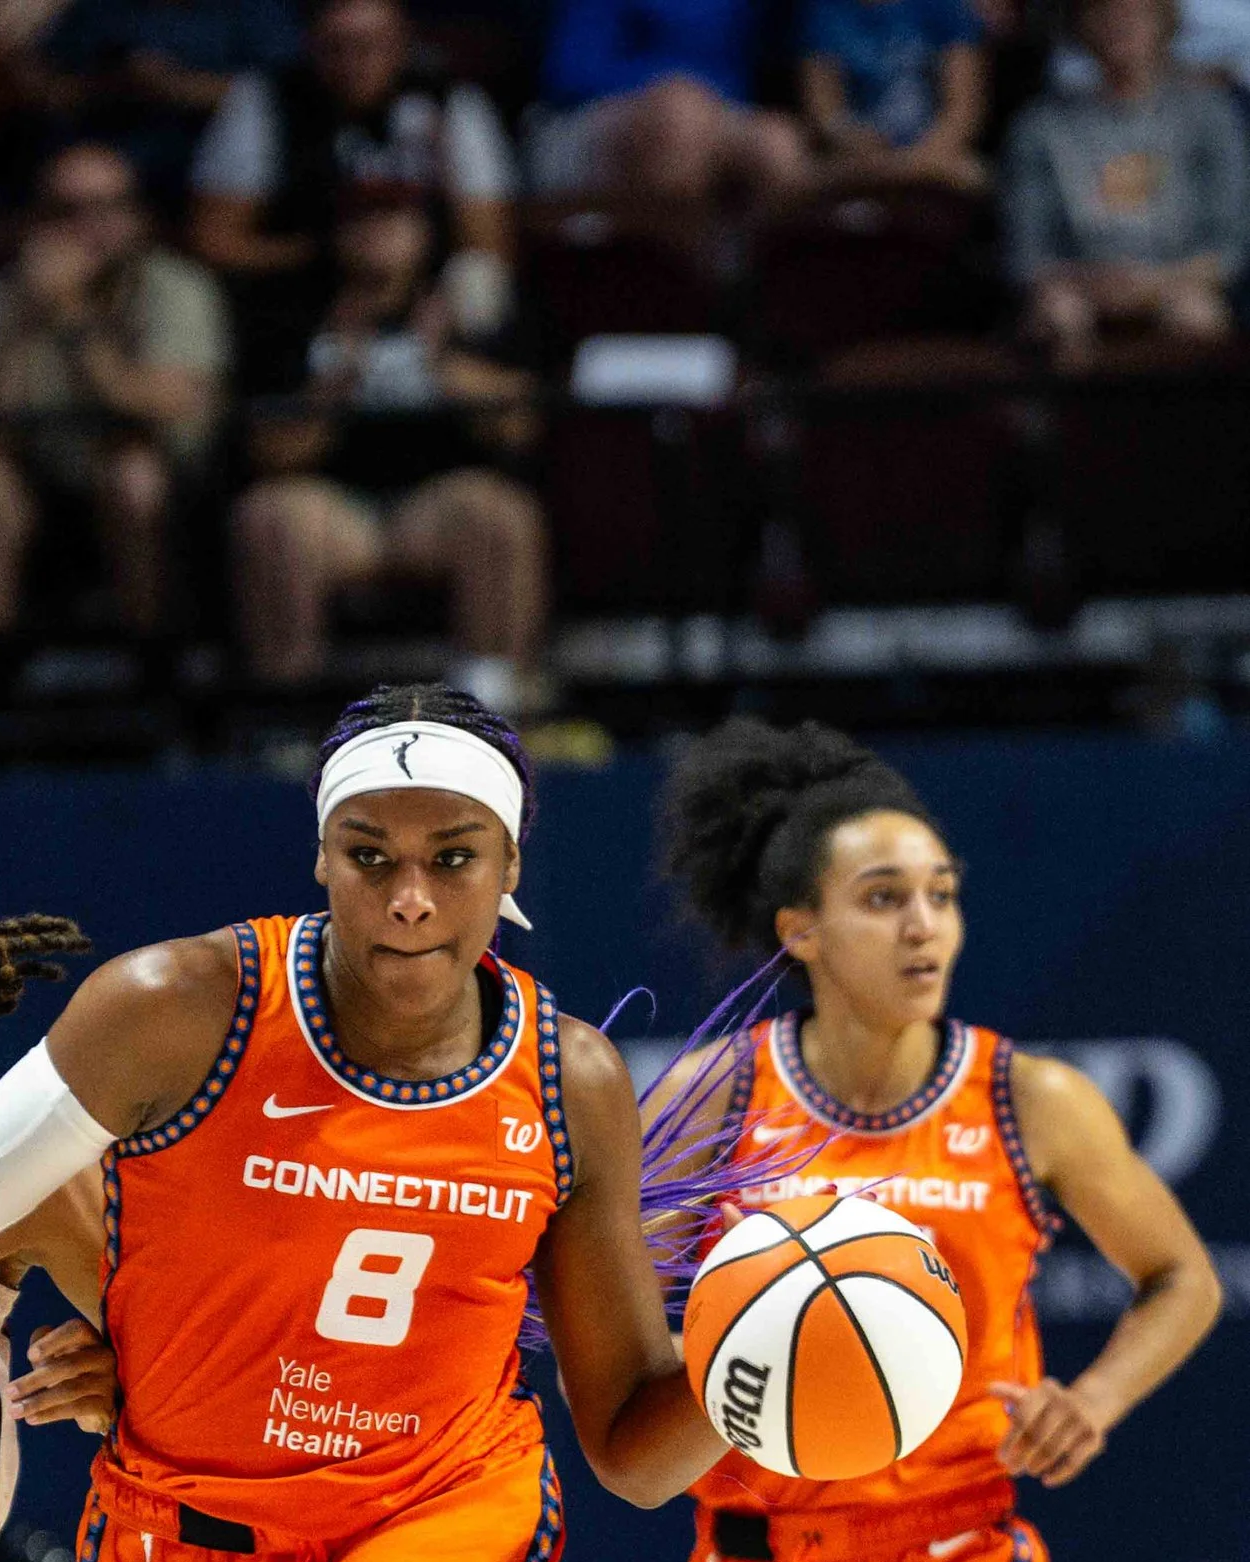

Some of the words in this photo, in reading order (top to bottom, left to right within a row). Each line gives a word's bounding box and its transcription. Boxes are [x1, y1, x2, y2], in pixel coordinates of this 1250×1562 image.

[243, 1154, 533, 1223] CONNECTICUT
[315, 1228, 435, 1347] 8
[278, 1356, 331, 1392] Yale
[269, 1388, 421, 1435] NewHaven
[262, 1418, 362, 1458] Health
